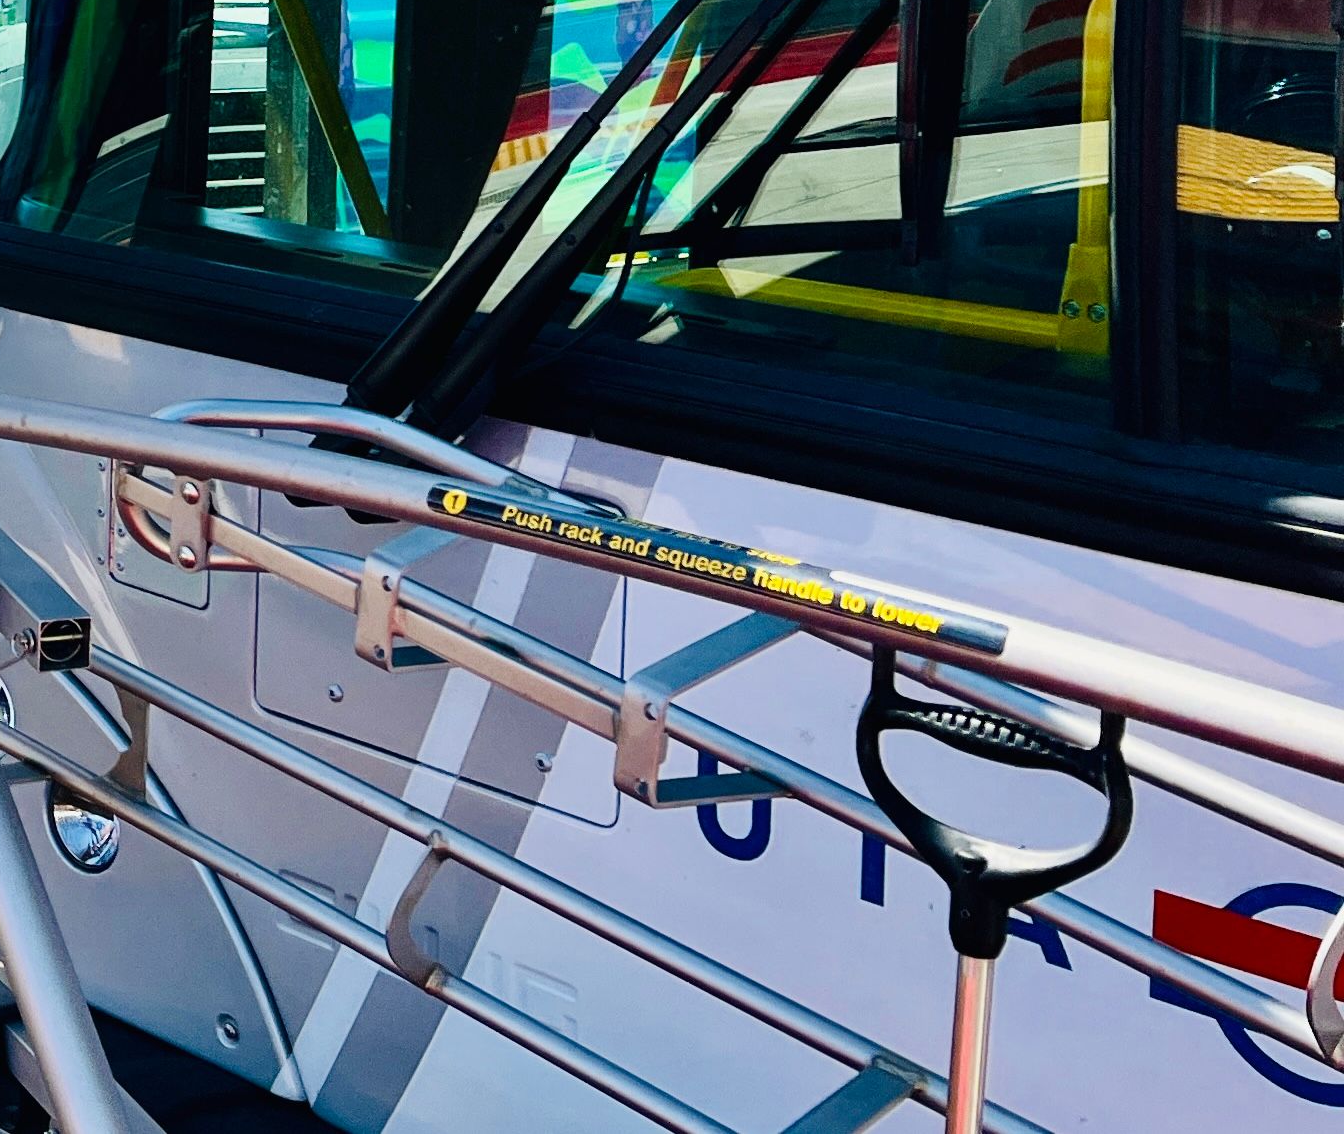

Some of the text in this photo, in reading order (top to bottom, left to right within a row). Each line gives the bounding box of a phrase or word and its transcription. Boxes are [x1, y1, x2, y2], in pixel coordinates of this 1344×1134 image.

[501, 505, 553, 533] Push
[558, 521, 605, 547] rack
[608, 537, 652, 558] and
[654, 545, 747, 582] squeeze
[752, 566, 835, 606] handle
[839, 589, 867, 614] to
[871, 596, 945, 635] lower
